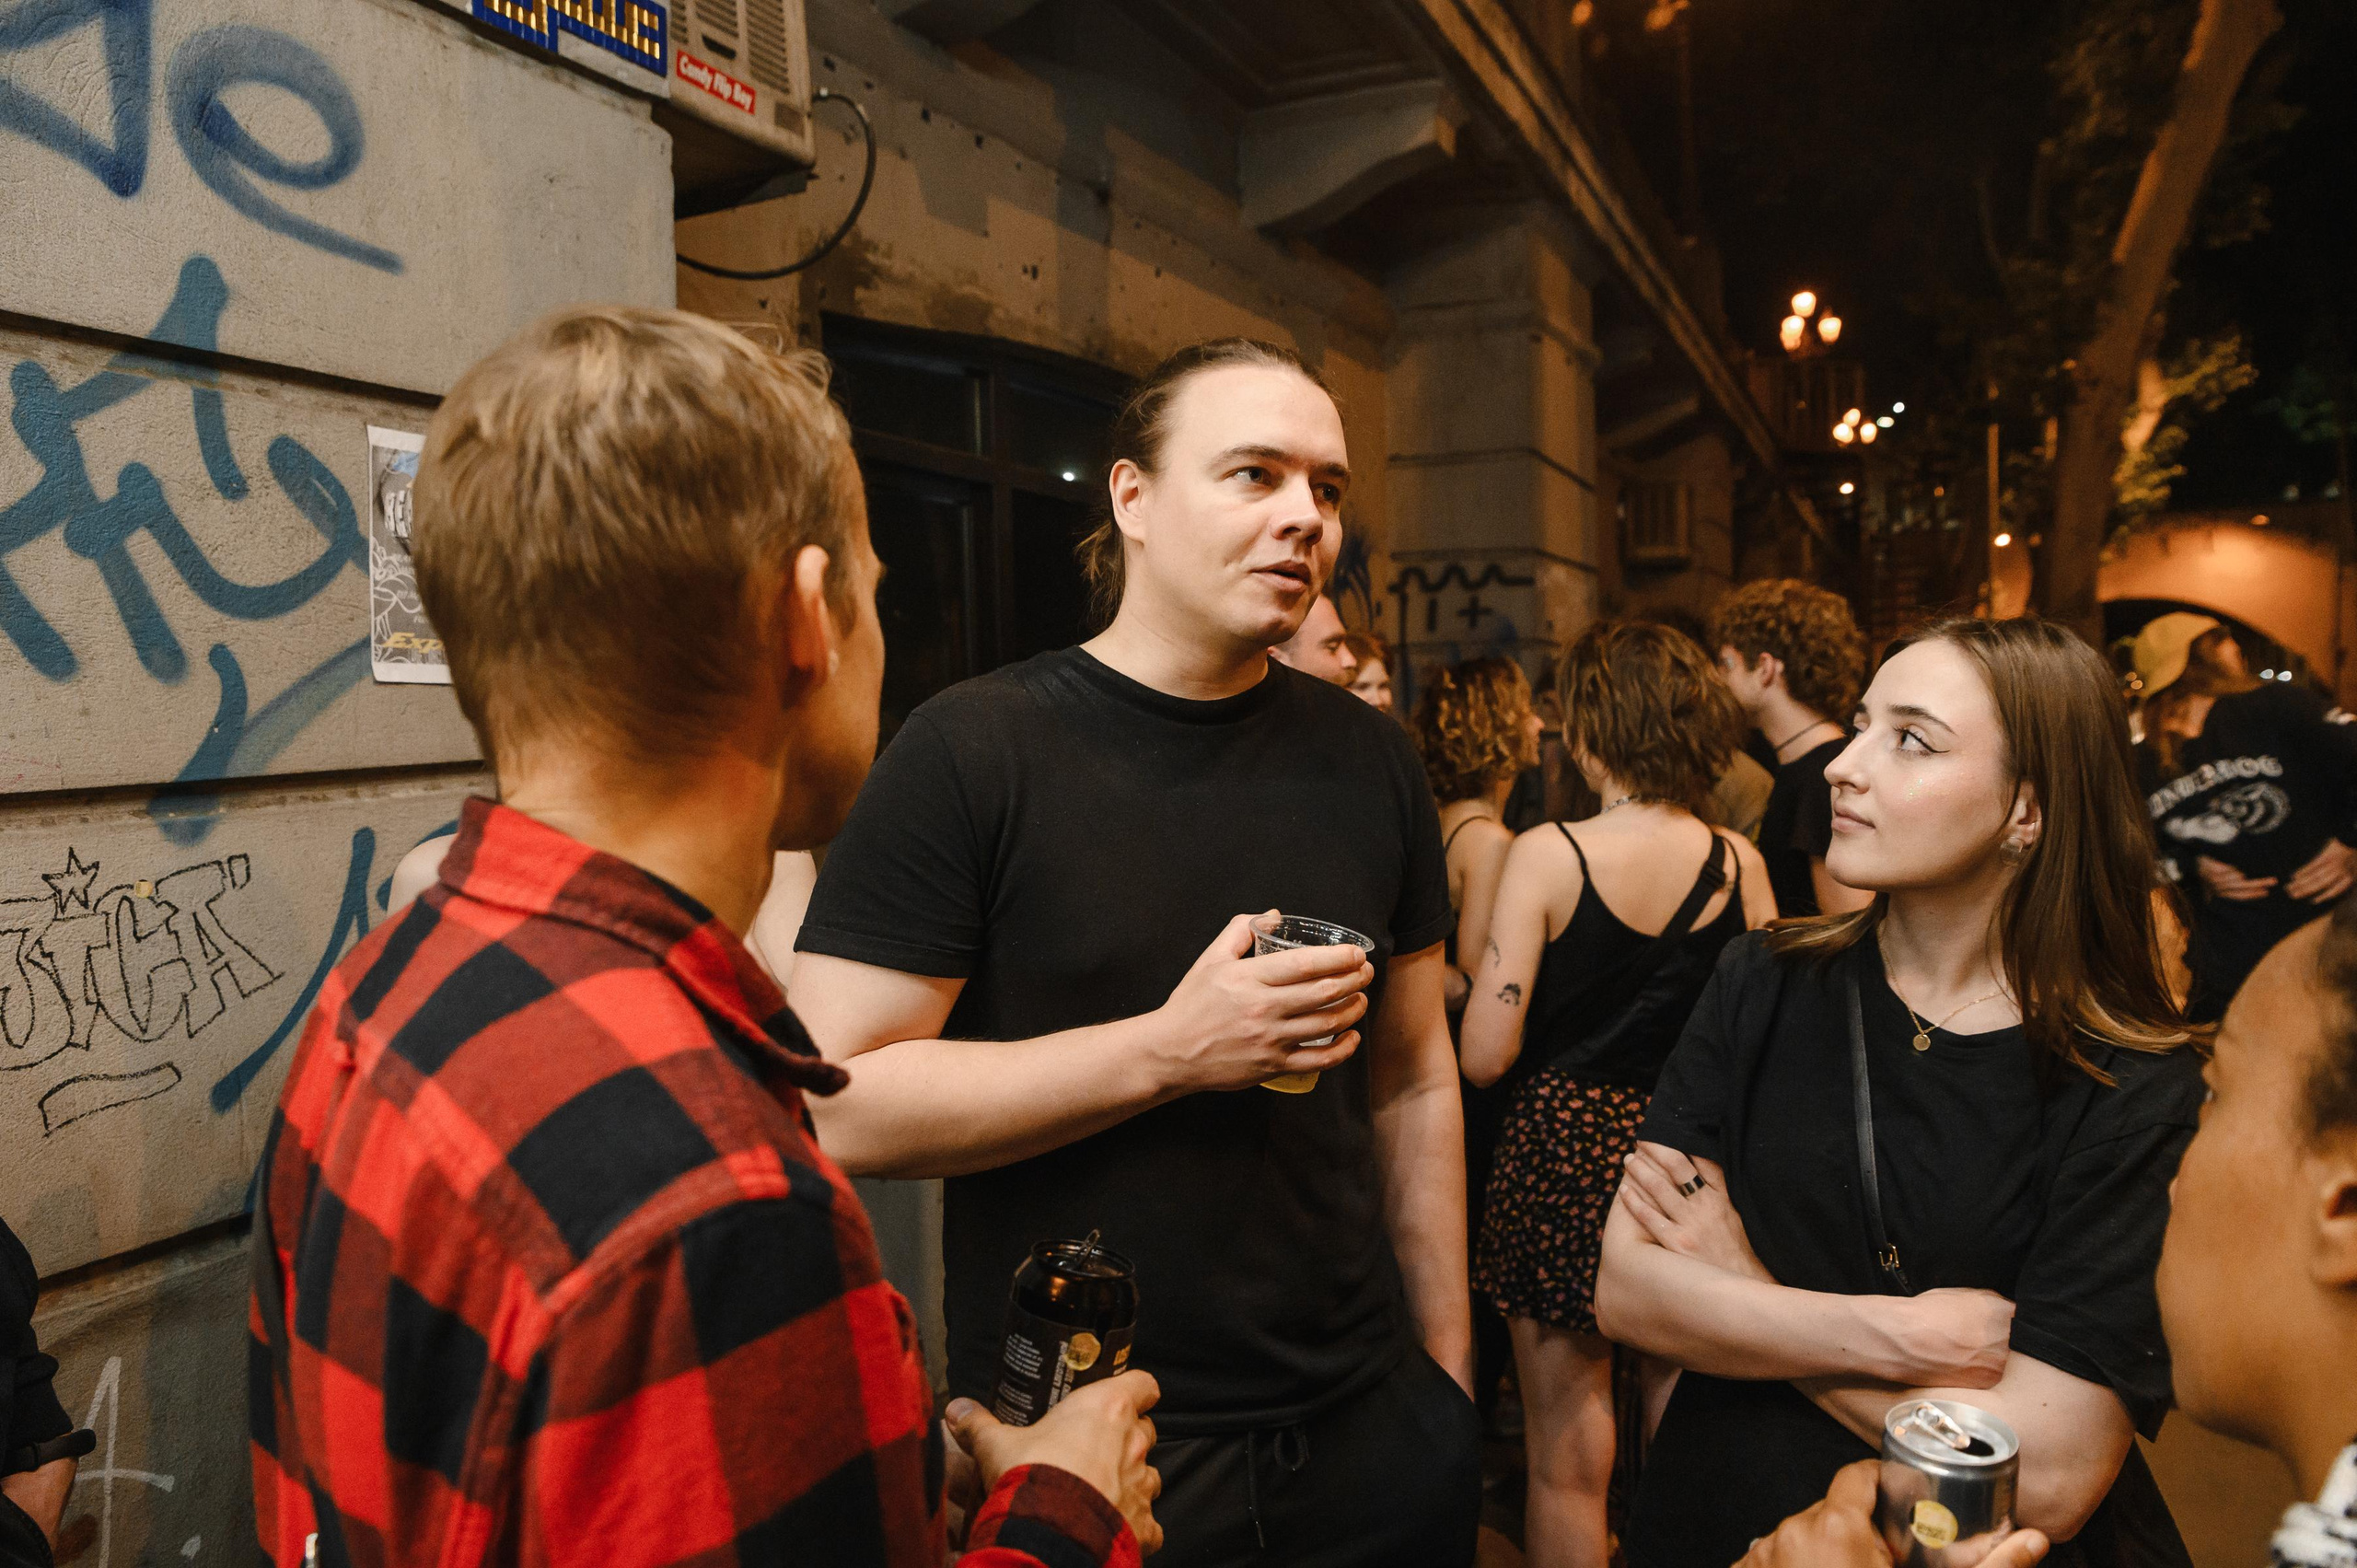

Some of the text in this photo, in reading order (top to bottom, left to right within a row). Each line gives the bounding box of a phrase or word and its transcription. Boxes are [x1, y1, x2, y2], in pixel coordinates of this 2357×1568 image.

[679, 55, 752, 110] Candy Flip Boy
[381, 632, 445, 654] Exp
